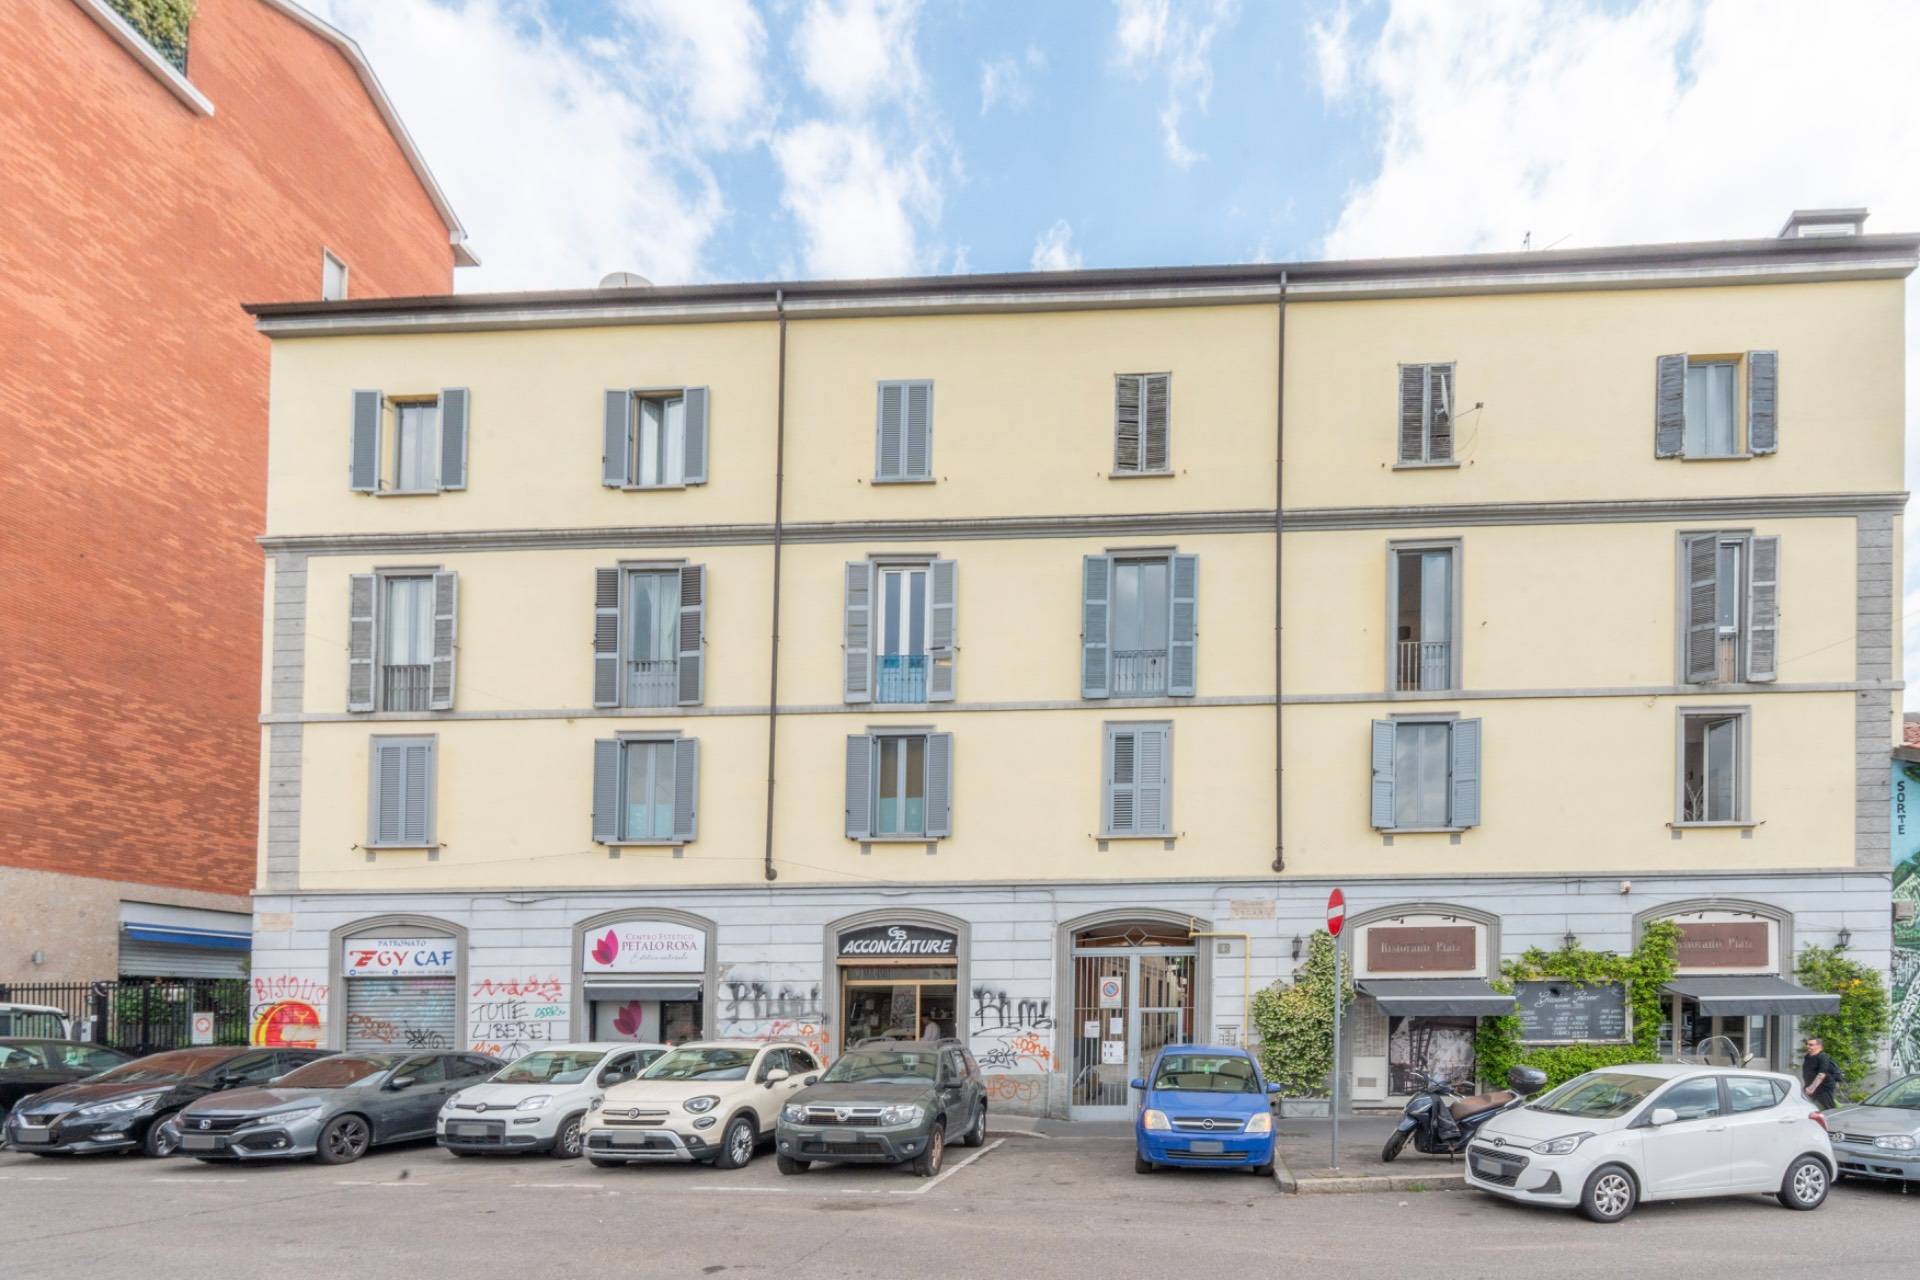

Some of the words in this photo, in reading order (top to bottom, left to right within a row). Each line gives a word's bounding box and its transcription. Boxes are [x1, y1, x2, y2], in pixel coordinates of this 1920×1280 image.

[1896, 780, 1906, 835] SORTE
[888, 926, 907, 940] GB
[842, 939, 952, 954] ACCONCIATURE
[414, 950, 454, 967] CAF
